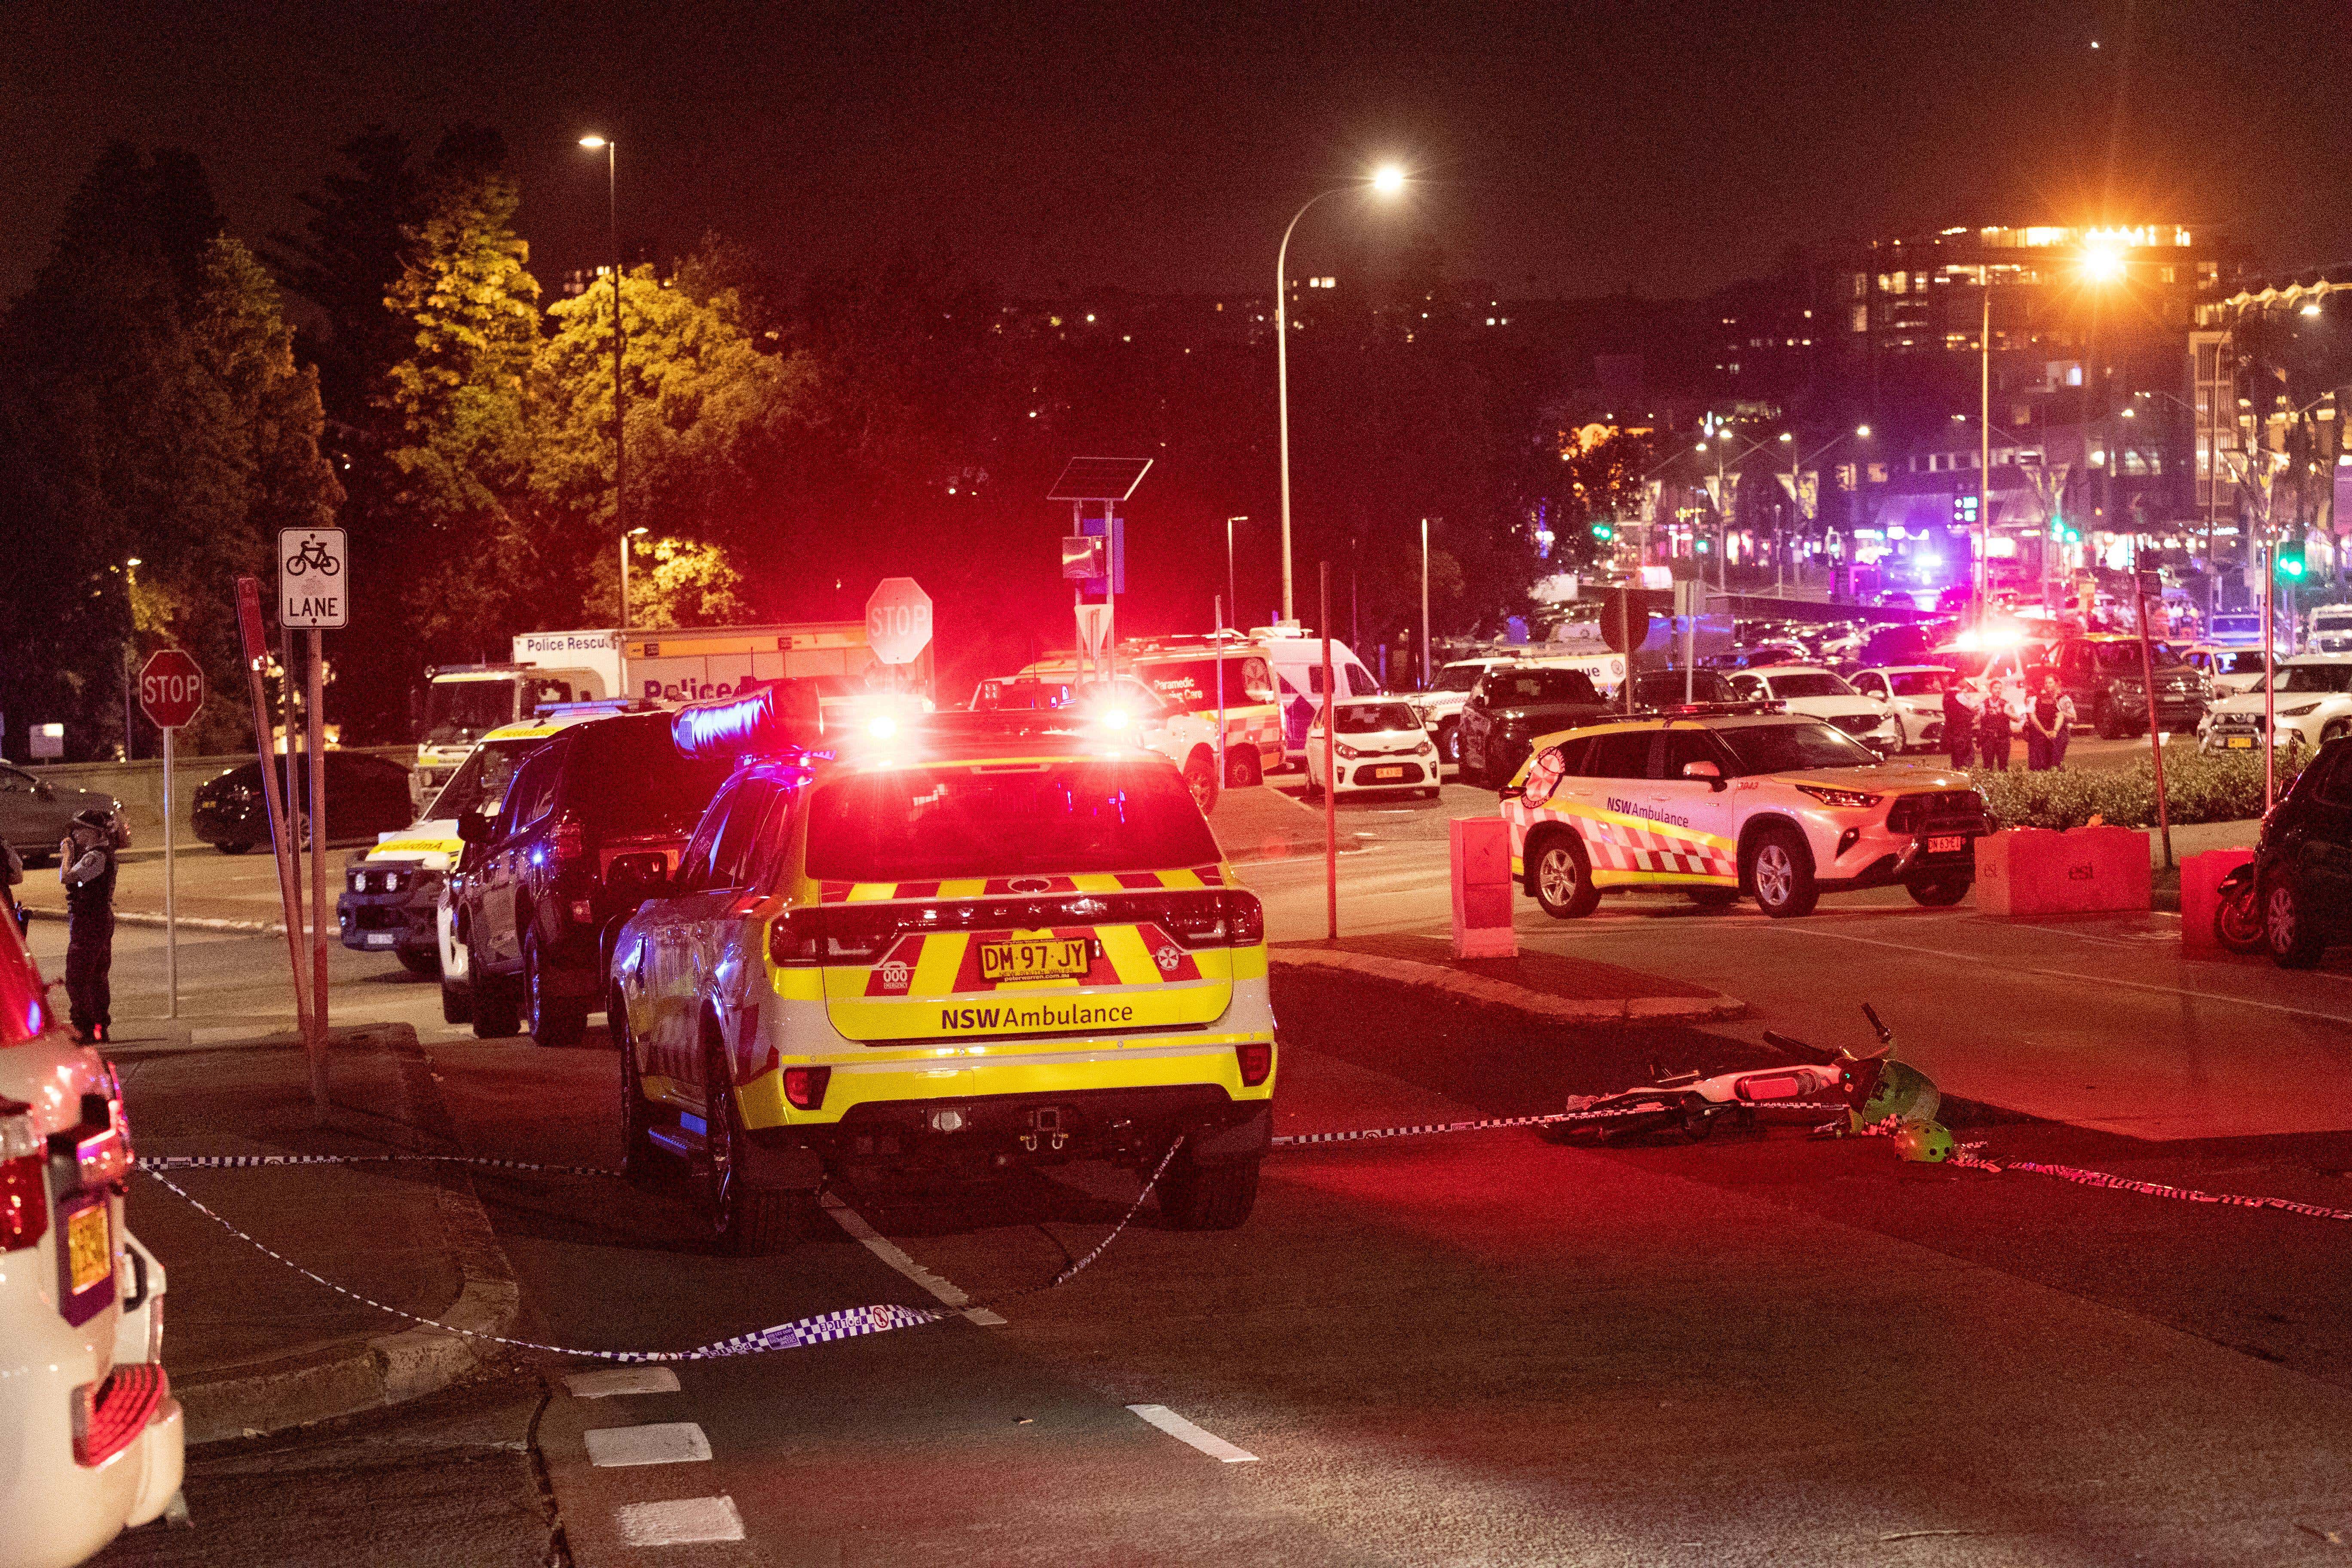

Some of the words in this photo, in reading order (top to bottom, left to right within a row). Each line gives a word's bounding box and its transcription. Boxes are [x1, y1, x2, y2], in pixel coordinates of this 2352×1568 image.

[289, 597, 338, 617] LANE
[871, 603, 927, 638] STOP
[528, 638, 564, 651] Police
[567, 637, 610, 649] Rescu
[144, 674, 200, 704] STOP
[645, 677, 729, 700] Police
[1154, 677, 1194, 690] Paramedic
[1184, 689, 1203, 699] Care
[1607, 797, 1632, 815] NSW
[1632, 803, 1689, 828] Ambulance
[883, 970, 908, 982] 000
[1004, 973, 1070, 982] peterwarren.com.au
[941, 1008, 1001, 1030] NSW
[1003, 1004, 1133, 1028] Ambulance
[819, 1317, 861, 1332] POLICE
